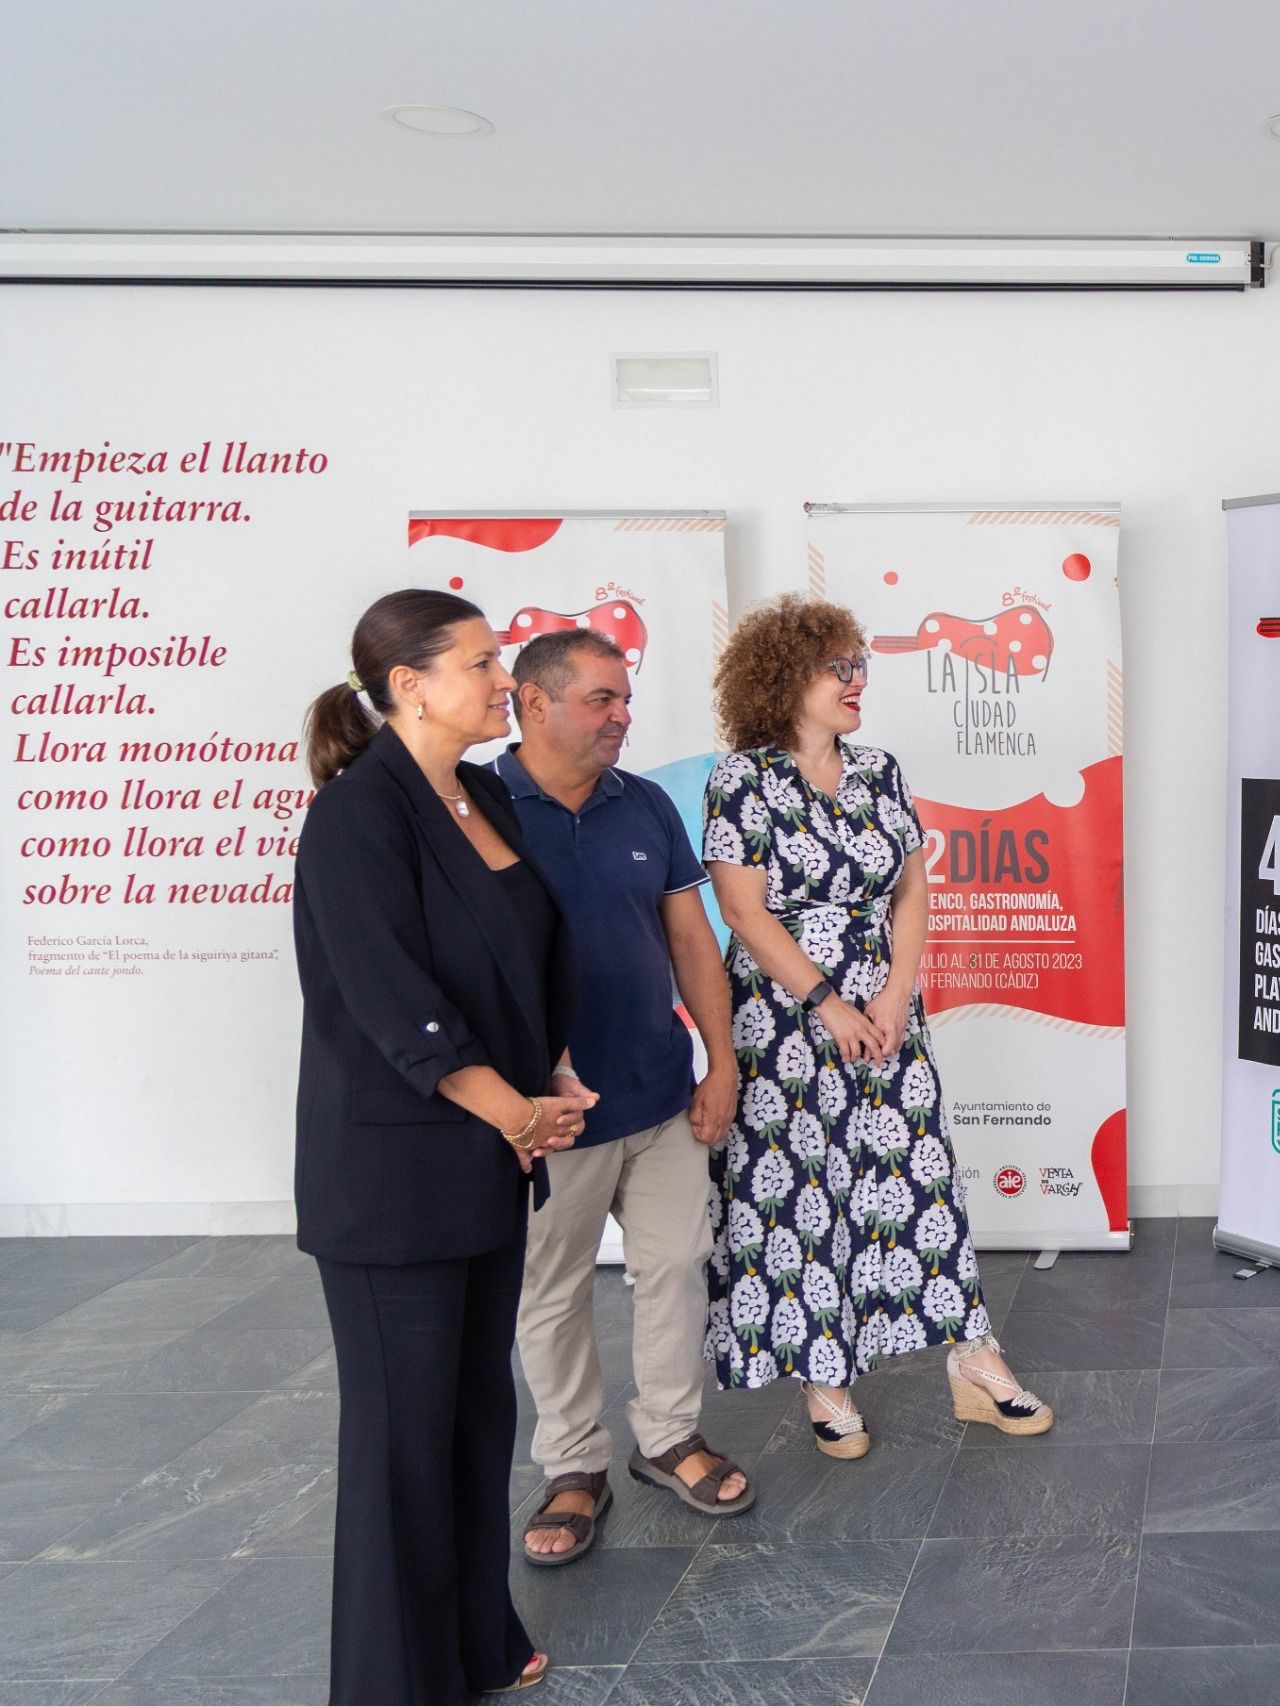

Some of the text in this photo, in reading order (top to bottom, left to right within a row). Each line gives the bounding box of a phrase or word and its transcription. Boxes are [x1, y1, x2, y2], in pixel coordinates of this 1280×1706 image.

[180, 441, 210, 473] el
[221, 441, 328, 474] llanto
[0, 489, 251, 532] de la guitarra.
[1, 538, 154, 570] Es inútil
[4, 587, 150, 619] callarla.
[7, 635, 227, 677] Es imposible
[927, 650, 1020, 694] LA ISLA
[11, 683, 156, 715] callarla.
[954, 700, 1016, 728] CIUDAD
[14, 731, 299, 763] Llora monótona
[957, 731, 1036, 756] FLAMENCA
[17, 779, 316, 820] como llora el agu
[21, 825, 300, 857] como llora el vie
[22, 873, 112, 905] sobre
[123, 873, 156, 904] la
[927, 890, 1063, 911] ENCO, GASTRONOMÍA,
[928, 915, 1076, 932] OSPITALIDAD ANDALUZA
[27, 936, 73, 946] Federico
[28, 950, 85, 963] fragmento
[87, 950, 100, 960] de
[123, 952, 160, 963] poema
[163, 950, 177, 960] de
[179, 950, 189, 960] la
[29, 966, 62, 976] Poema
[65, 965, 80, 976] del
[83, 966, 109, 976] cante
[951, 953, 965, 968] AL
[969, 953, 982, 969] 31
[986, 953, 999, 969] DE
[1003, 953, 1048, 969] AGOSTO
[1052, 953, 1083, 970] 2023
[931, 973, 992, 989] FERNANDO
[953, 1101, 1051, 1113] Ayuntamiento de
[953, 1114, 1051, 1126] San Fernando
[1000, 1172, 1021, 1188] aie
